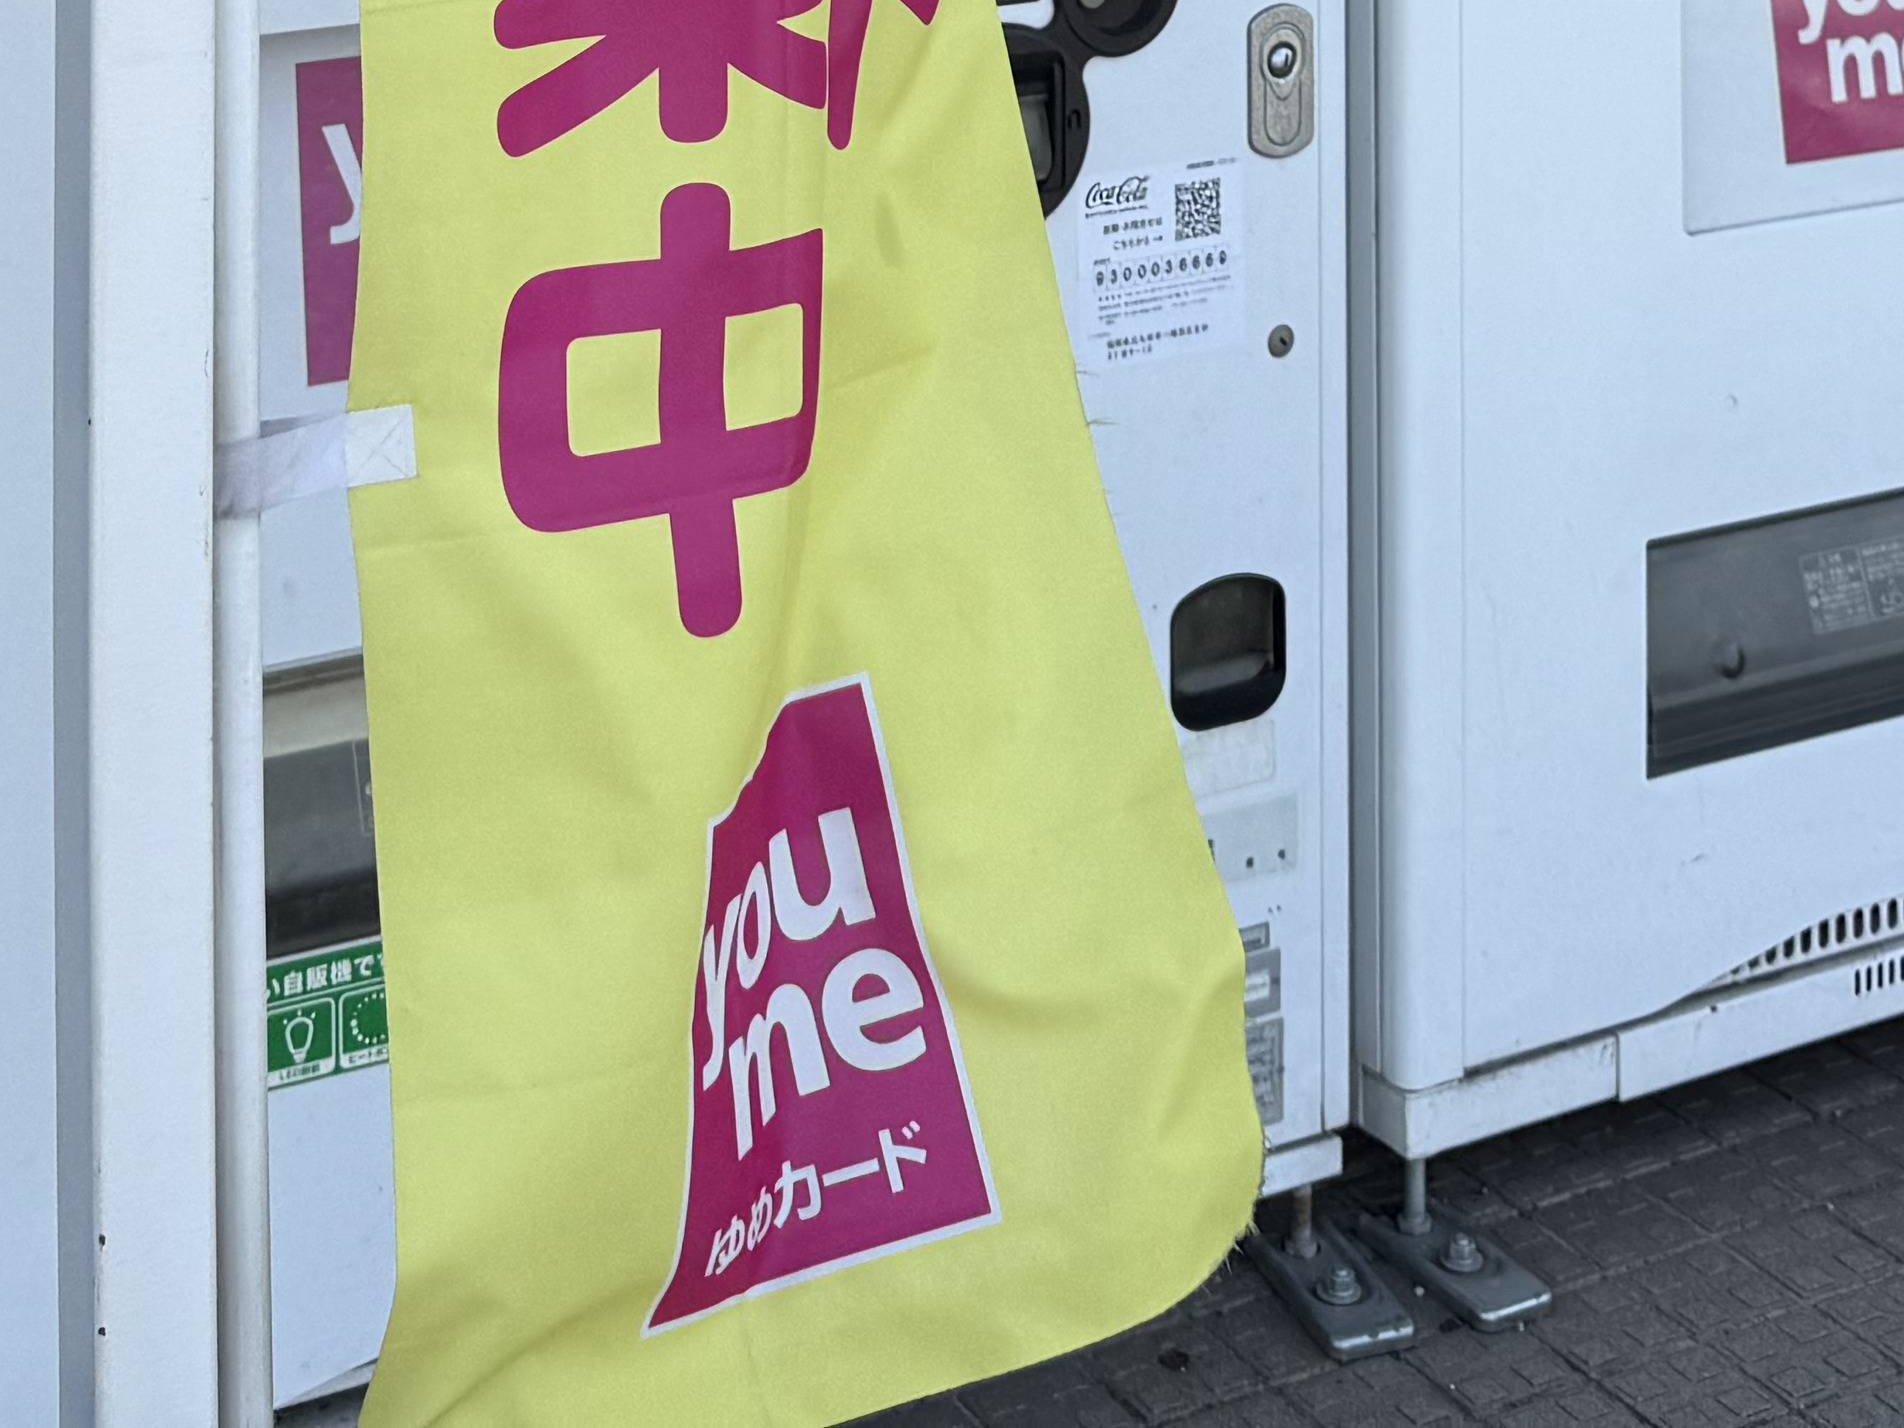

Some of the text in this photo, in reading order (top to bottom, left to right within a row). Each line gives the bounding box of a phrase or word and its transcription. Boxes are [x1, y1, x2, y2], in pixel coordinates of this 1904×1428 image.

[702, 806, 876, 1092] you
[728, 947, 927, 1160] me
[703, 1119, 927, 1277] ゆめカード
